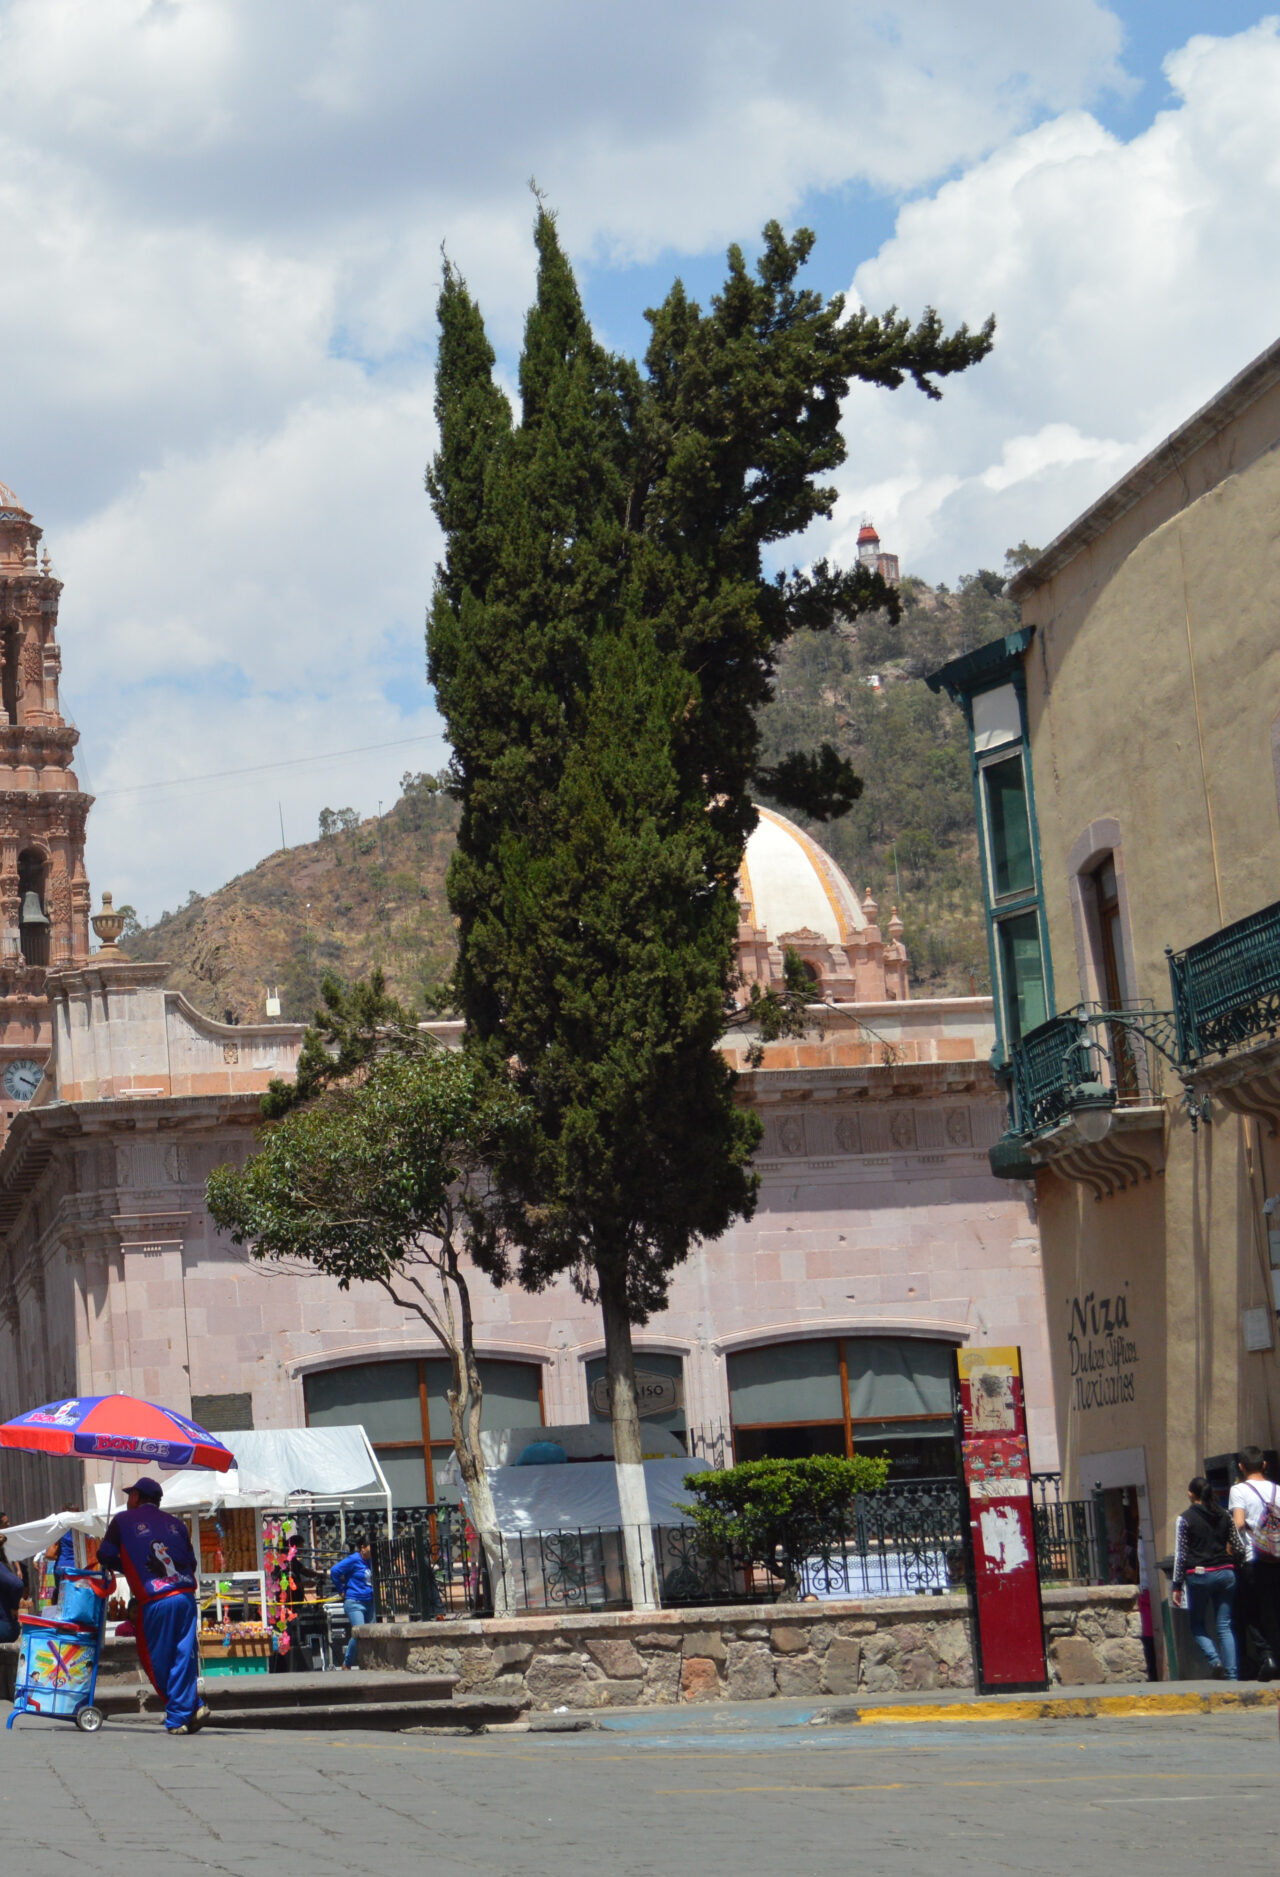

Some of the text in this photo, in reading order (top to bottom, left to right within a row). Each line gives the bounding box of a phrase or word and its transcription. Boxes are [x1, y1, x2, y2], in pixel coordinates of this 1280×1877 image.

[1067, 1291, 1129, 1340] Niza
[1070, 1336, 1105, 1376] Dulces
[1073, 1372, 1135, 1411] Mexicanos
